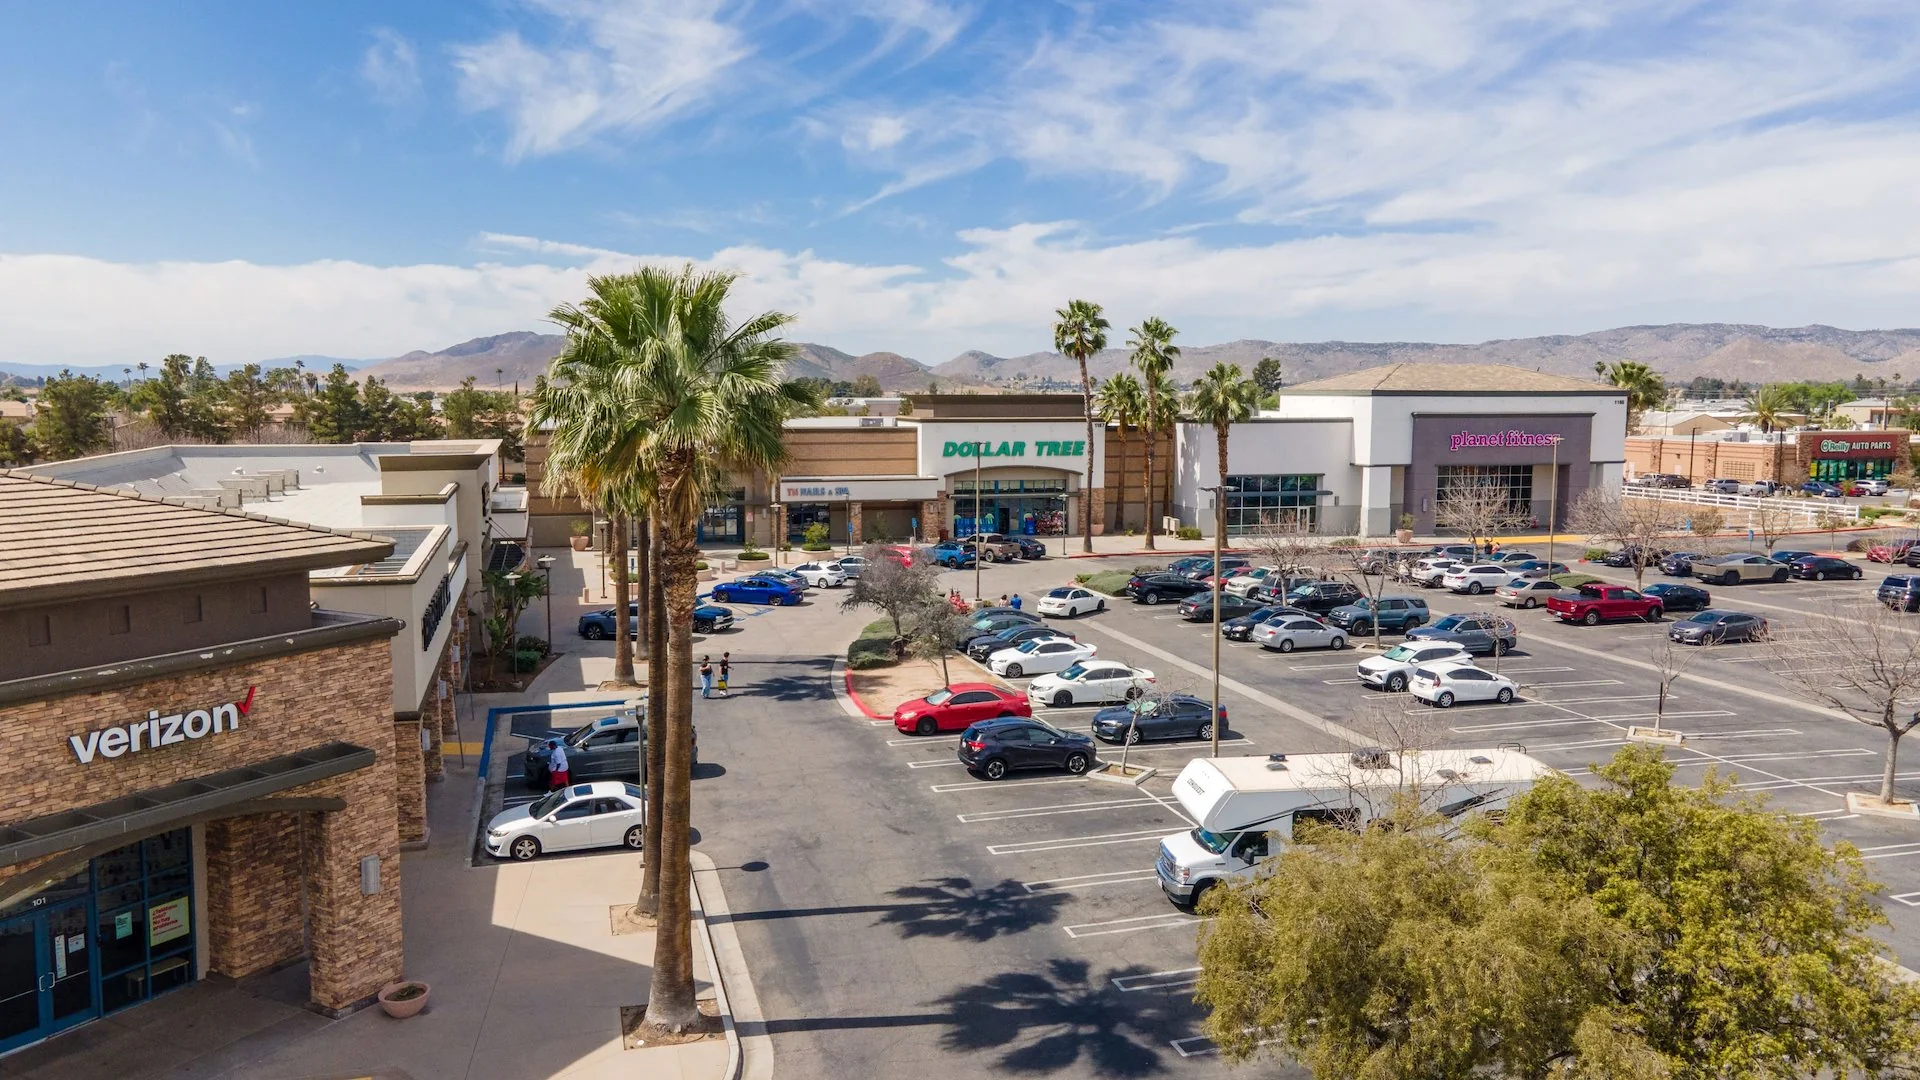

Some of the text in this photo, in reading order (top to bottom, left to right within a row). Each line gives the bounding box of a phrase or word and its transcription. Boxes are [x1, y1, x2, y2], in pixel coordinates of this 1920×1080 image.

[1450, 430, 1560, 451] planet fitness
[1821, 440, 1850, 453] O'Reilly
[1870, 442, 1891, 450] PARTS
[942, 441, 1086, 458] DOLLAR TREE
[800, 487, 826, 496] NAILS
[69, 702, 239, 764] verizon
[32, 897, 46, 906] 101
